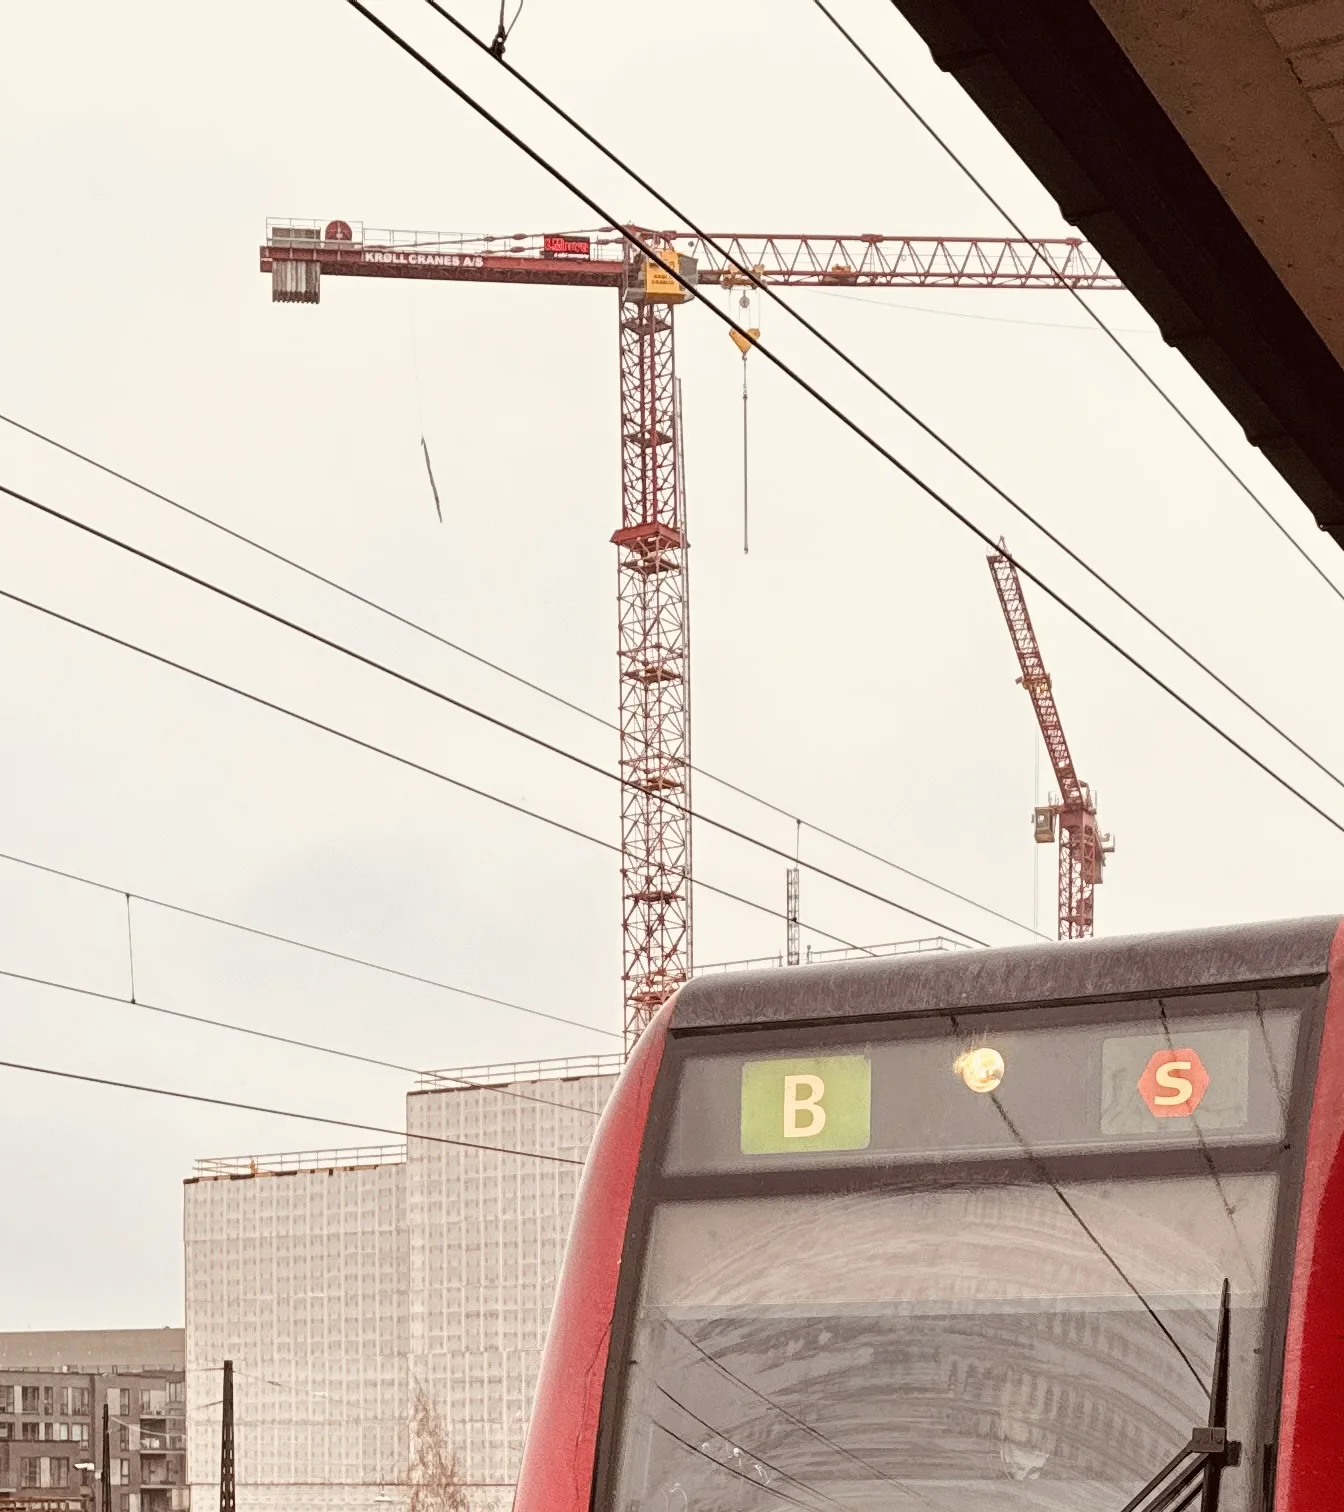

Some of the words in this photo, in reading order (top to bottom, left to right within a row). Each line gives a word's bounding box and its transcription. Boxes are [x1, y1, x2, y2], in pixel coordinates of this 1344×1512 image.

[365, 252, 408, 264] KRØLL
[408, 254, 460, 266] CRANES
[463, 256, 484, 267] A/S
[783, 1074, 827, 1138] B
[1154, 1061, 1193, 1106] S
